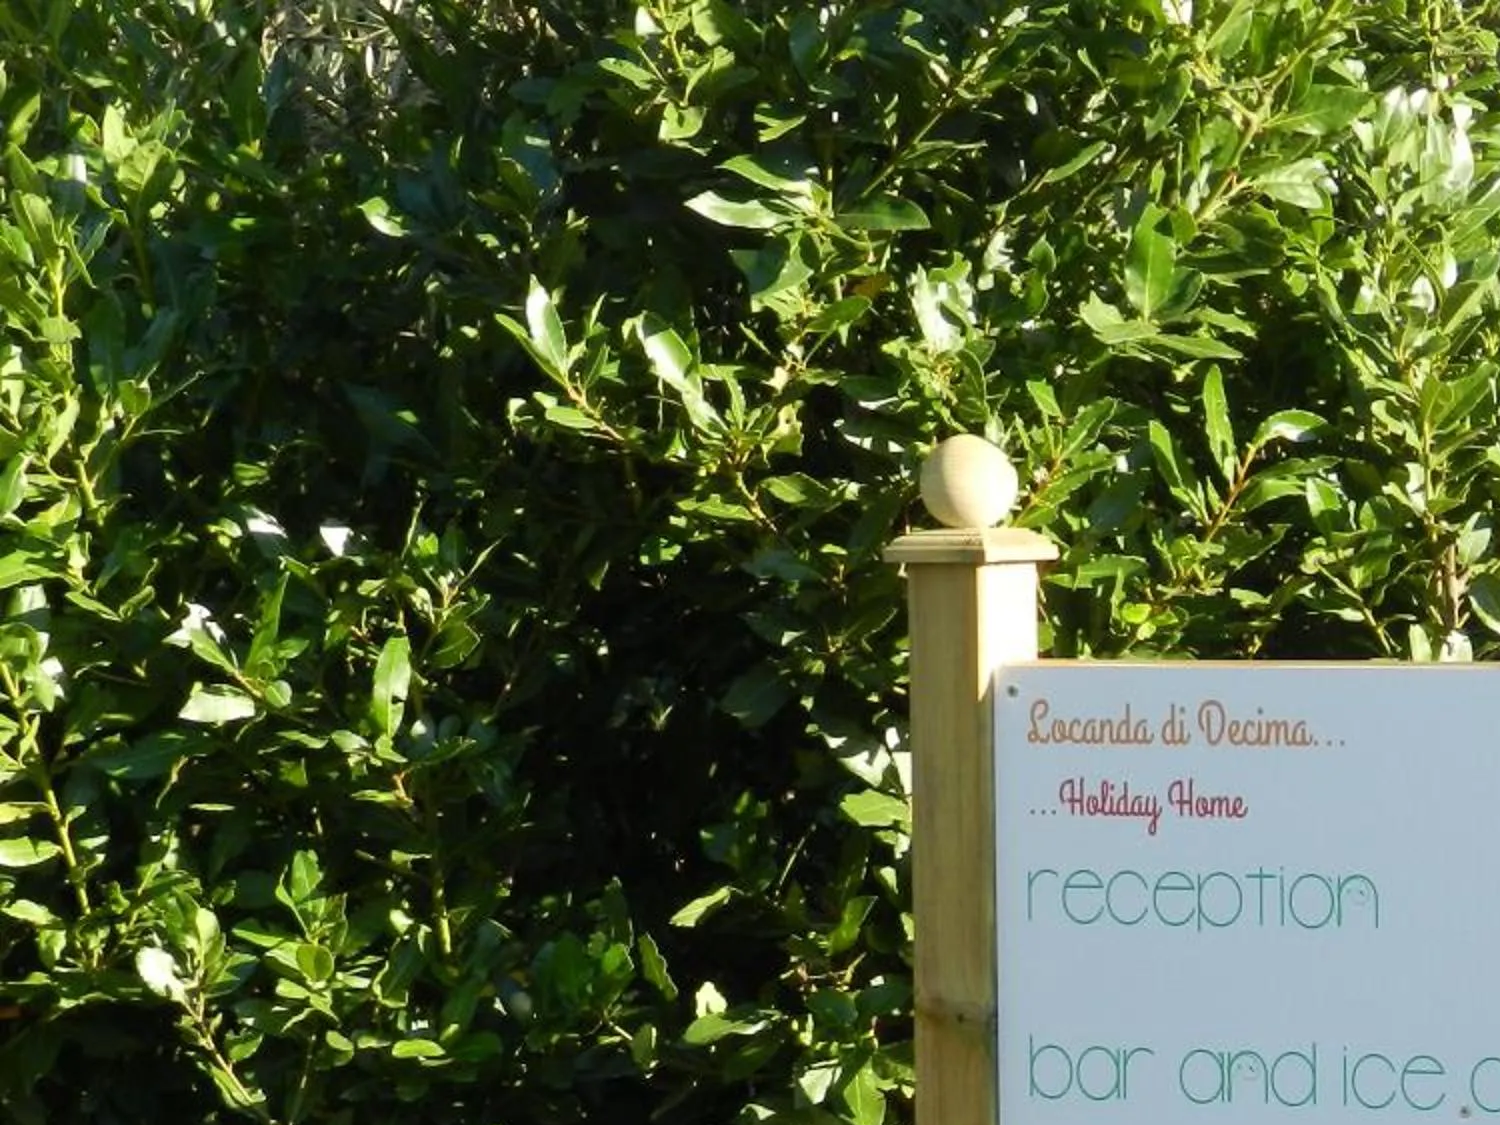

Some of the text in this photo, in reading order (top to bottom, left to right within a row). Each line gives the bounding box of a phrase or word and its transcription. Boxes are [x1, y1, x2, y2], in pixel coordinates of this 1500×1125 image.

[1027, 699, 1346, 747] Locanda di Decima...
[1168, 777, 1249, 819] Home
[1027, 865, 1380, 932] reception
[1028, 1034, 1155, 1101] bar
[1179, 1042, 1318, 1107] and
[1342, 1045, 1447, 1111] ice
